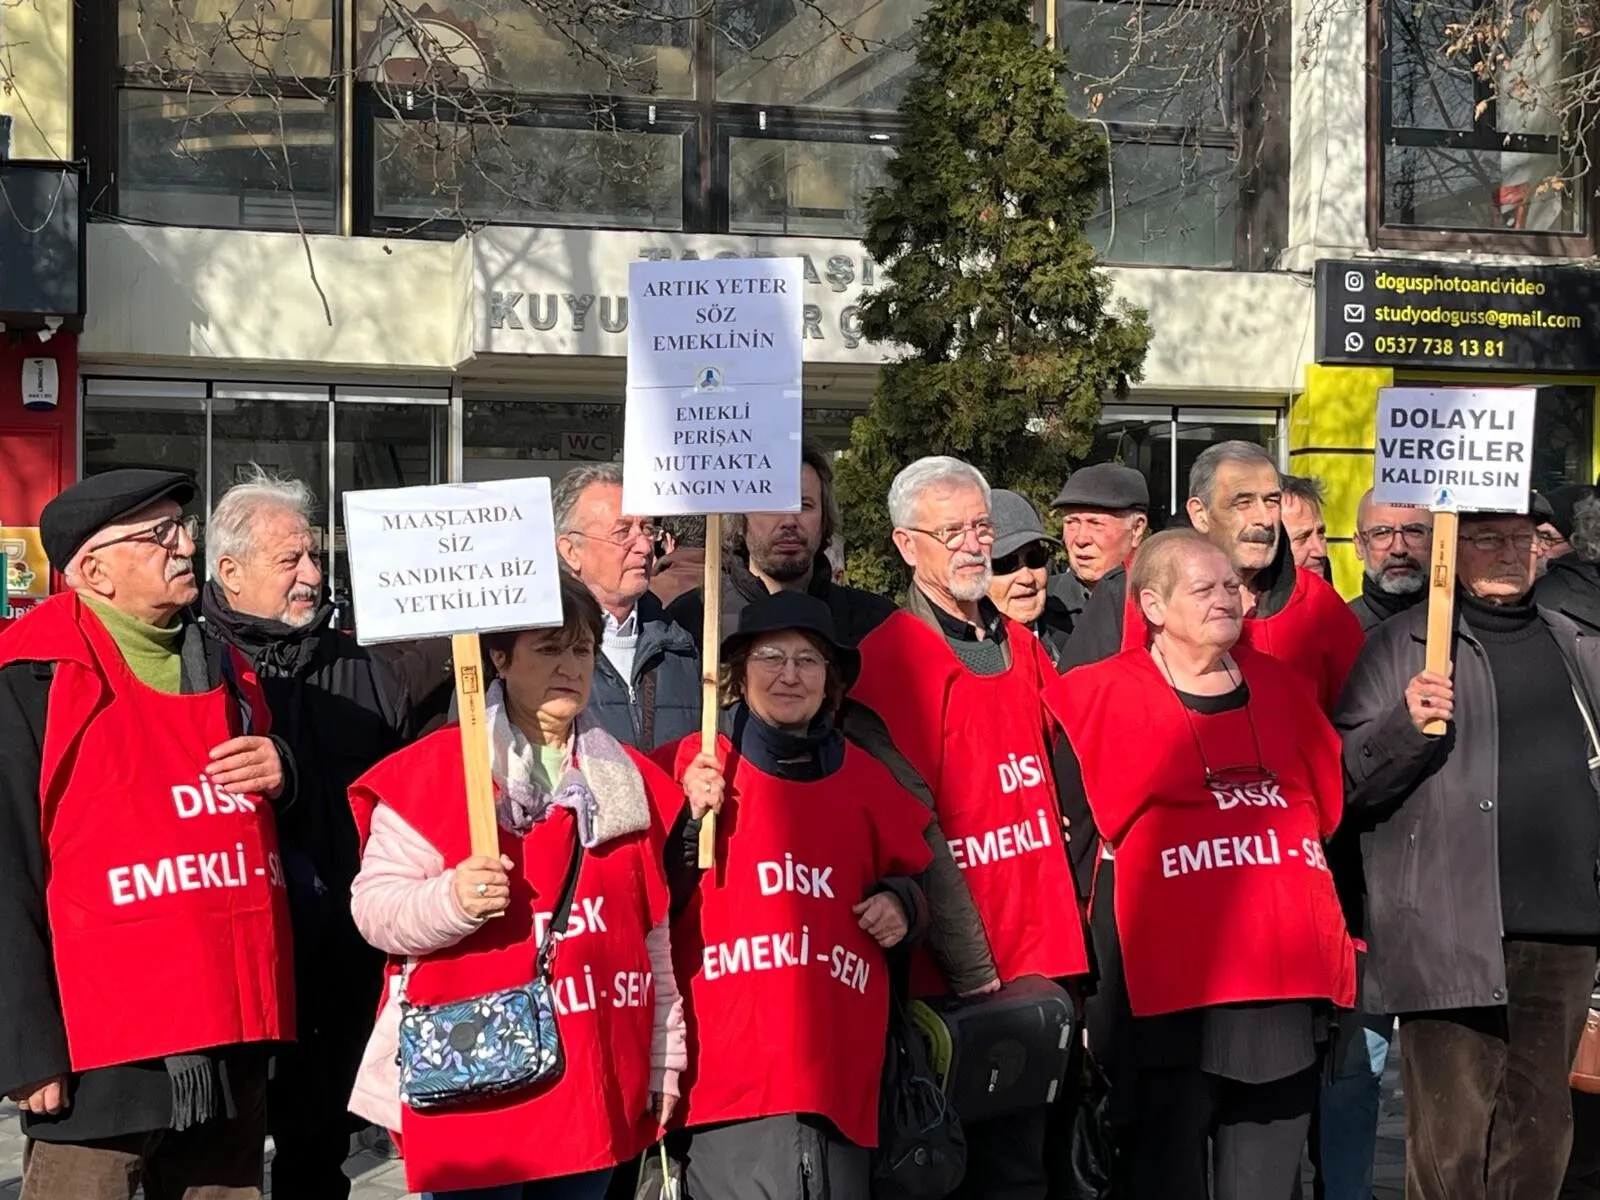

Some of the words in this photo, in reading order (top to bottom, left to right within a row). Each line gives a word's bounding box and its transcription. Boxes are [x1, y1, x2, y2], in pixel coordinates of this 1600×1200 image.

[643, 279, 710, 297] ARTIK
[715, 278, 788, 295] YETER
[1374, 271, 1546, 297] dogusphotoandvideo
[695, 303, 737, 324] SÖZ
[1374, 304, 1582, 329] studyodoguss@gmail.com
[653, 328, 775, 351] EMEKLİNİN
[1374, 336, 1418, 355] 0537
[1422, 337, 1453, 356] 738
[1459, 339, 1480, 357] 13
[1484, 340, 1505, 357] 81
[676, 401, 751, 422] EMEKLİ
[1390, 407, 1516, 430] DOLAYLI
[567, 434, 606, 451] WC
[673, 426, 753, 447] PERİŞAN
[1378, 434, 1525, 463] VERGİLER
[653, 453, 773, 472] MUTFAKTA
[653, 480, 726, 496] YANGIN
[732, 479, 773, 495] VAR
[1381, 467, 1520, 488] KALDIRILSIN
[382, 504, 524, 531] MAAŞLARDA
[438, 532, 474, 554] SİZ
[378, 563, 494, 588] SANDIKTA
[500, 556, 537, 578] BİZ
[393, 584, 527, 614] YETKİLİYİZ
[947, 808, 1052, 870] EMEKLİ
[1161, 828, 1282, 878] EMEKLİ
[1301, 837, 1328, 872] SE
[107, 842, 248, 906] EMEKLİ
[757, 852, 835, 899] DİSK
[702, 925, 809, 981] EMEKLİ
